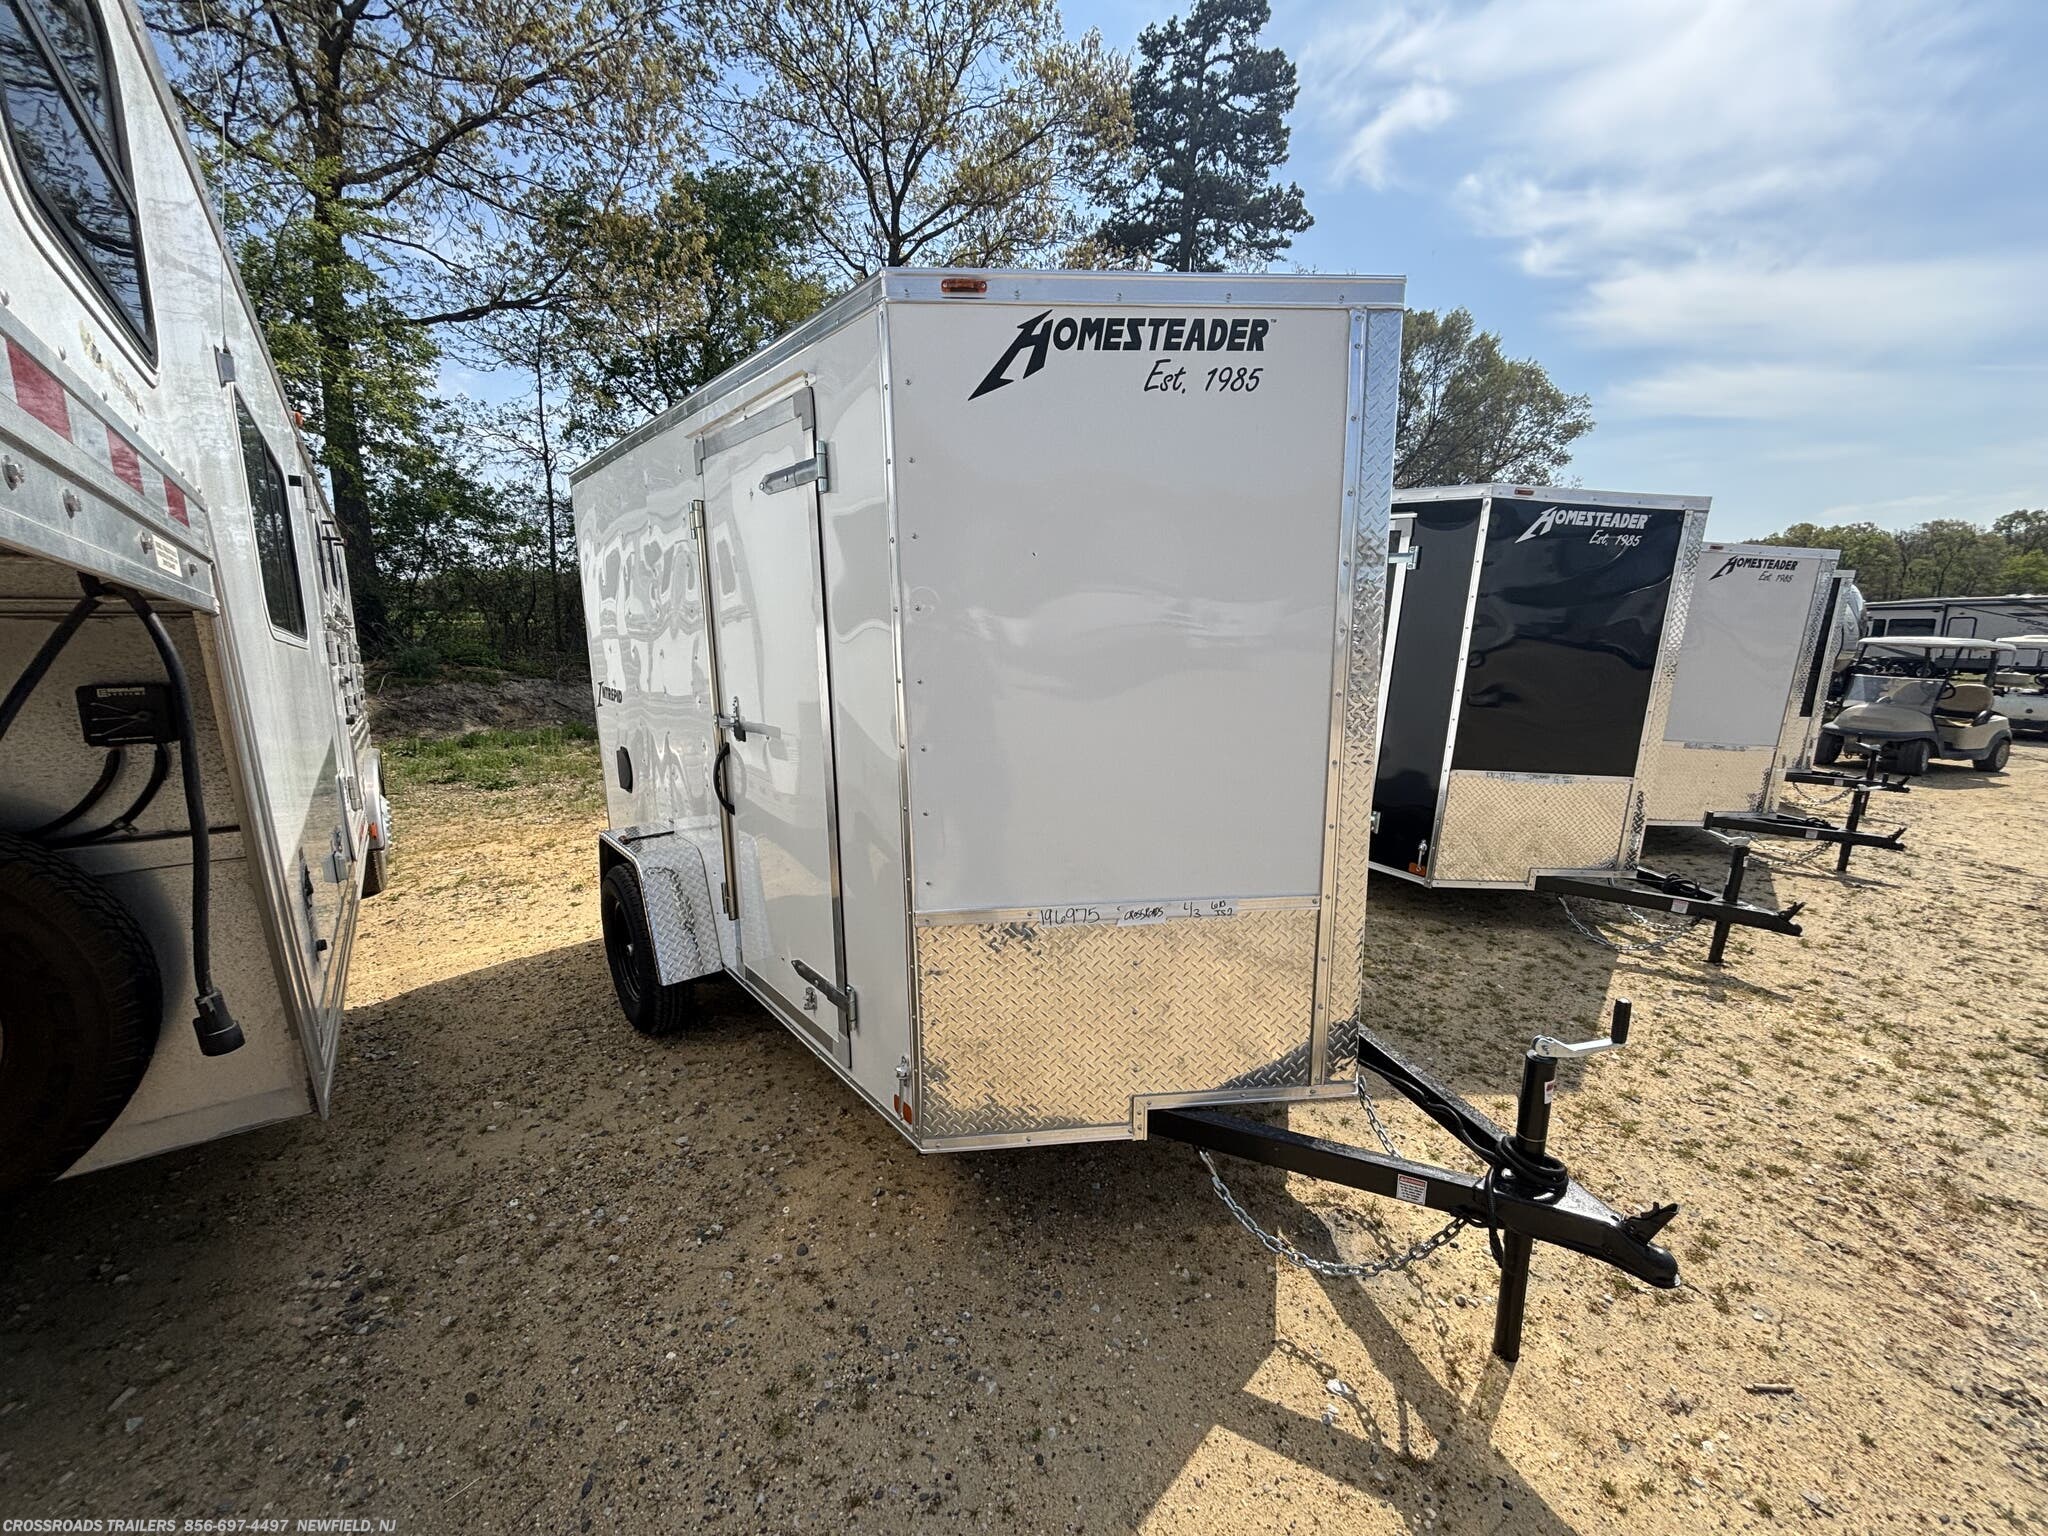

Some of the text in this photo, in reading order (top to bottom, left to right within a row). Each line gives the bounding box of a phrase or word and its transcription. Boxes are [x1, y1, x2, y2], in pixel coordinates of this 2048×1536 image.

[968, 309, 1270, 401] HOMESTEADER
[1205, 367, 1264, 392] 1985
[1515, 506, 1650, 544] HOMESTEADER
[1615, 535, 1642, 547] 1985
[1709, 555, 1798, 581] HOMESTEADER
[596, 681, 623, 708] INTREPID
[1041, 906, 1100, 926] 196975
